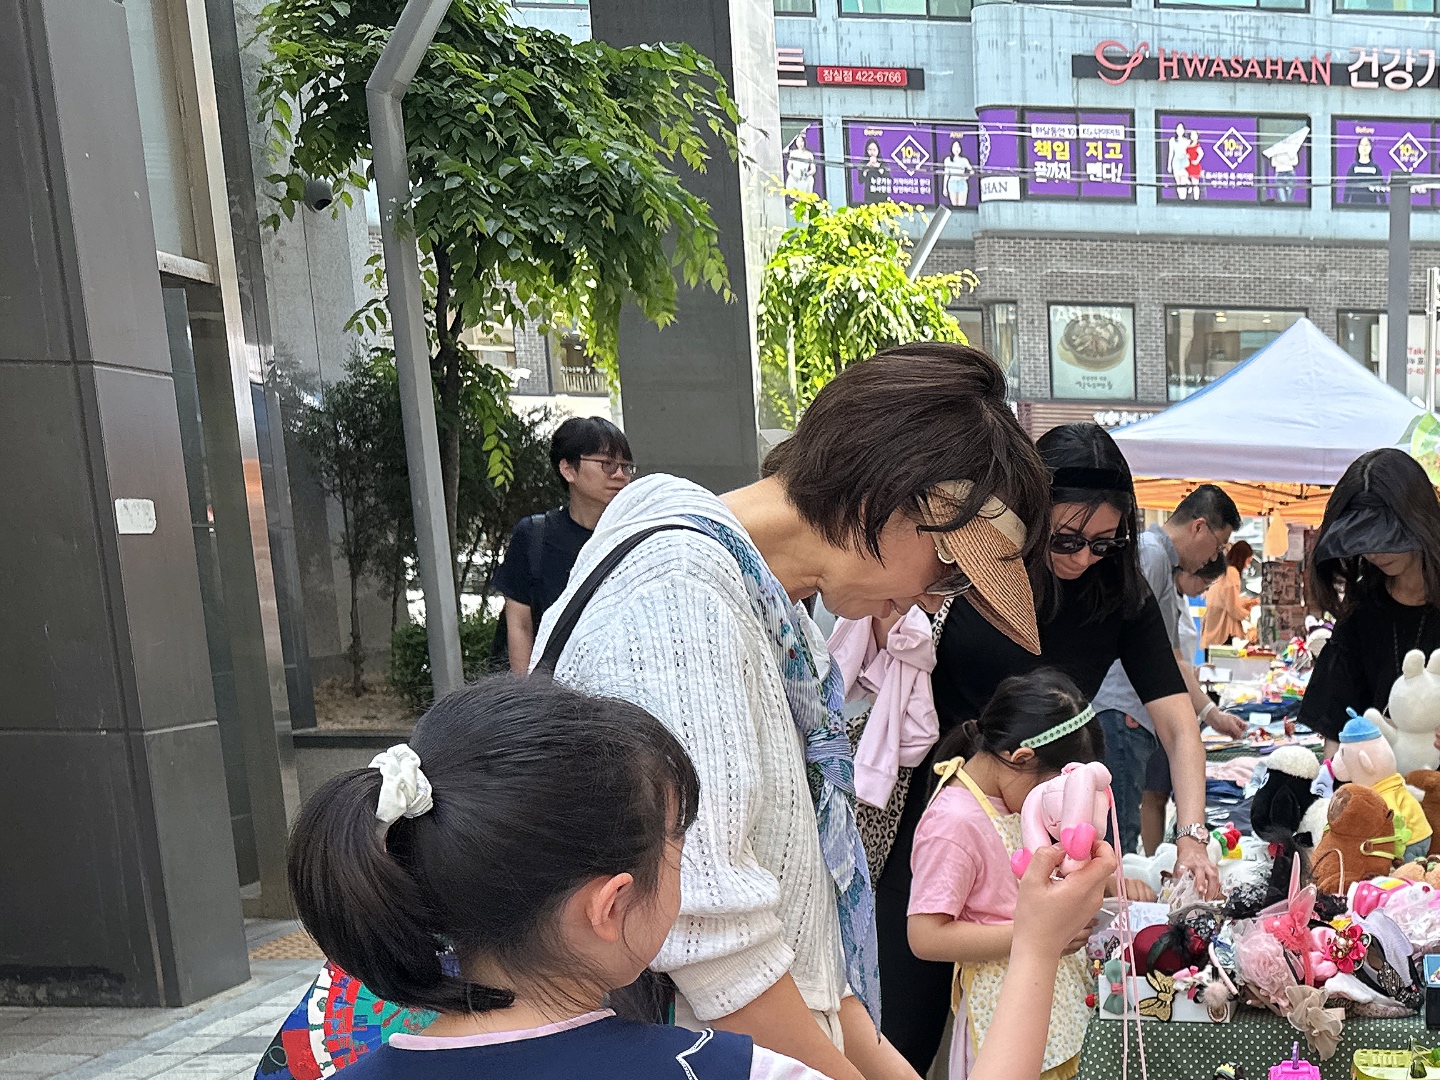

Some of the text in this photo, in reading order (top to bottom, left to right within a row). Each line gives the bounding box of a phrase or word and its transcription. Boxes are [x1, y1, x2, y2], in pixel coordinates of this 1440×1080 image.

[823, 69, 901, 83] 잠실점 422-6766
[1158, 47, 1331, 86] HWASAHAN
[1033, 140, 1123, 160] 책임 지고
[1033, 161, 1070, 183] 끝까지
